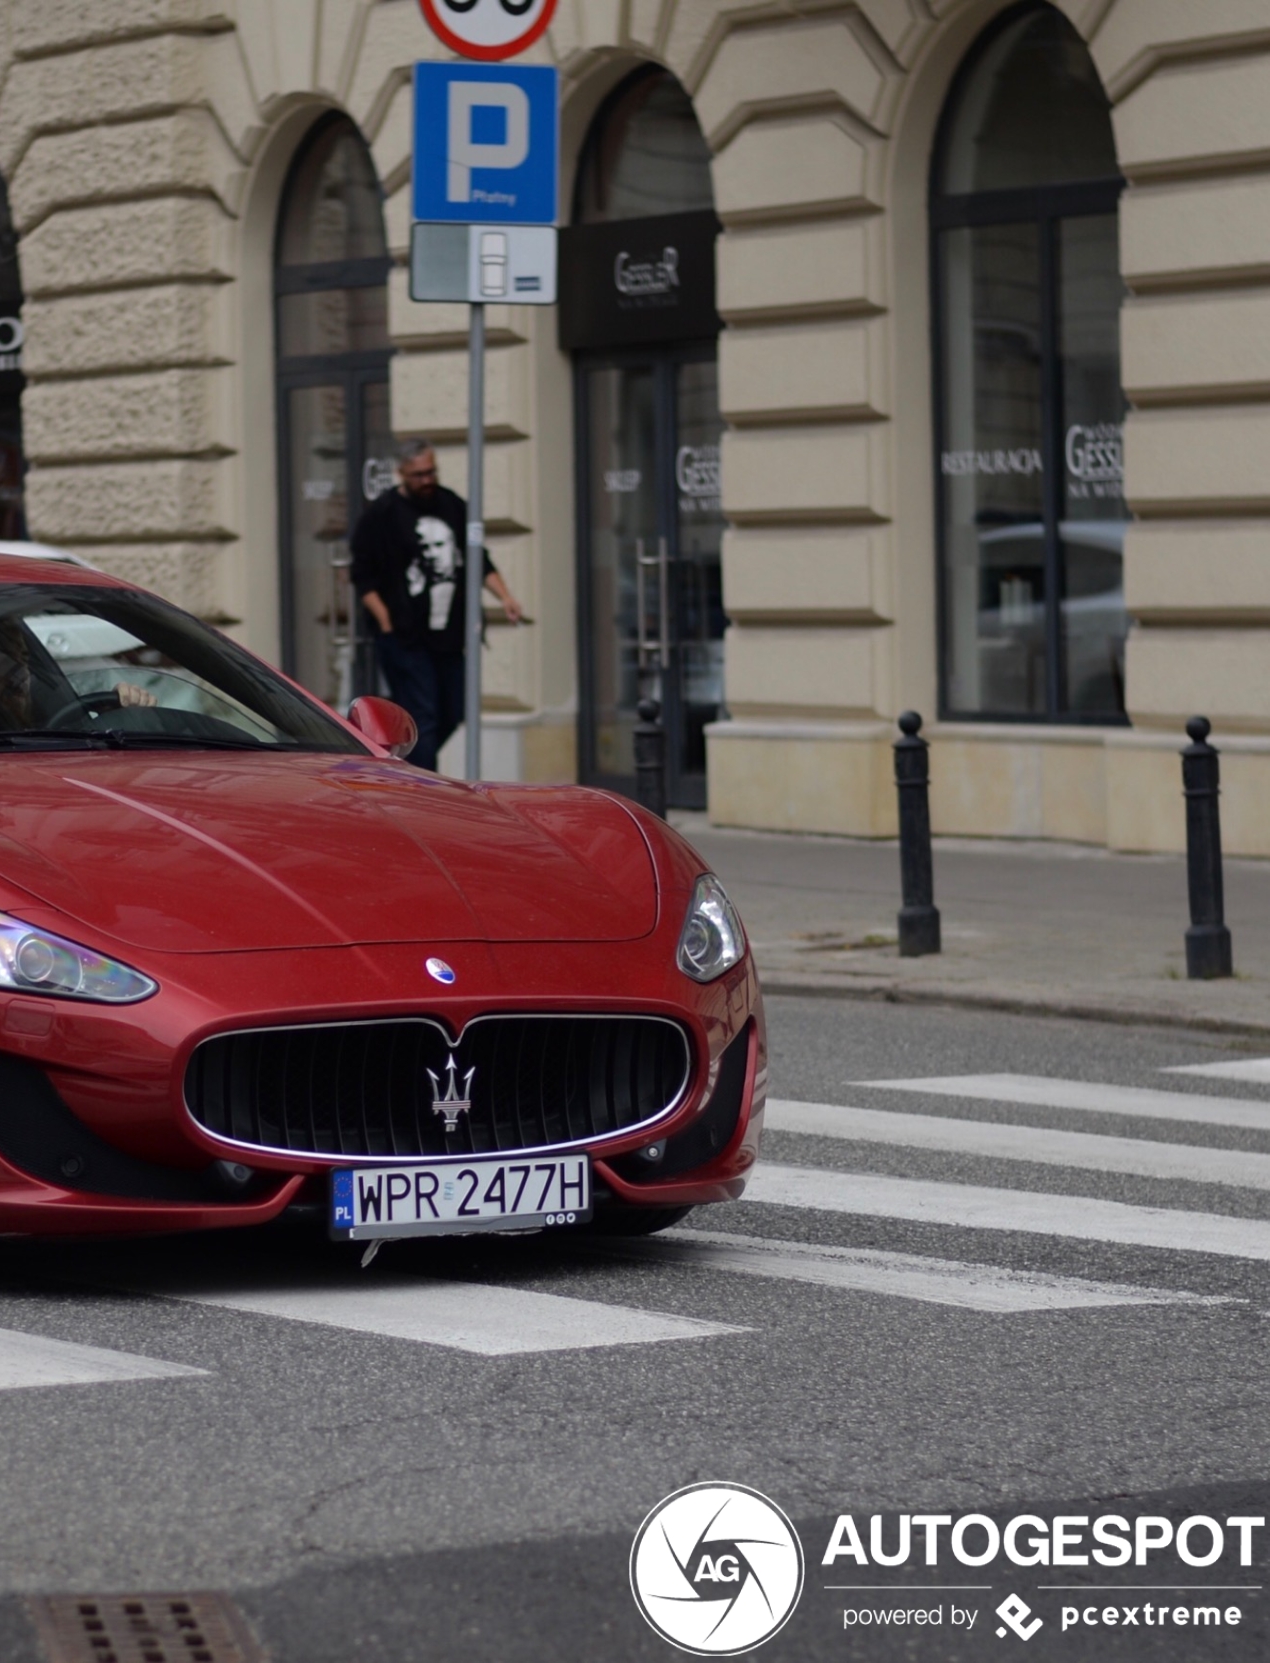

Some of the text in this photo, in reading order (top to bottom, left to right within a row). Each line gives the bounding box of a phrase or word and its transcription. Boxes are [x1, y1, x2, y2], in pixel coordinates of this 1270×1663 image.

[447, 80, 530, 203] P
[335, 1206, 351, 1221] PL
[358, 1161, 585, 1223] WPR 2477H
